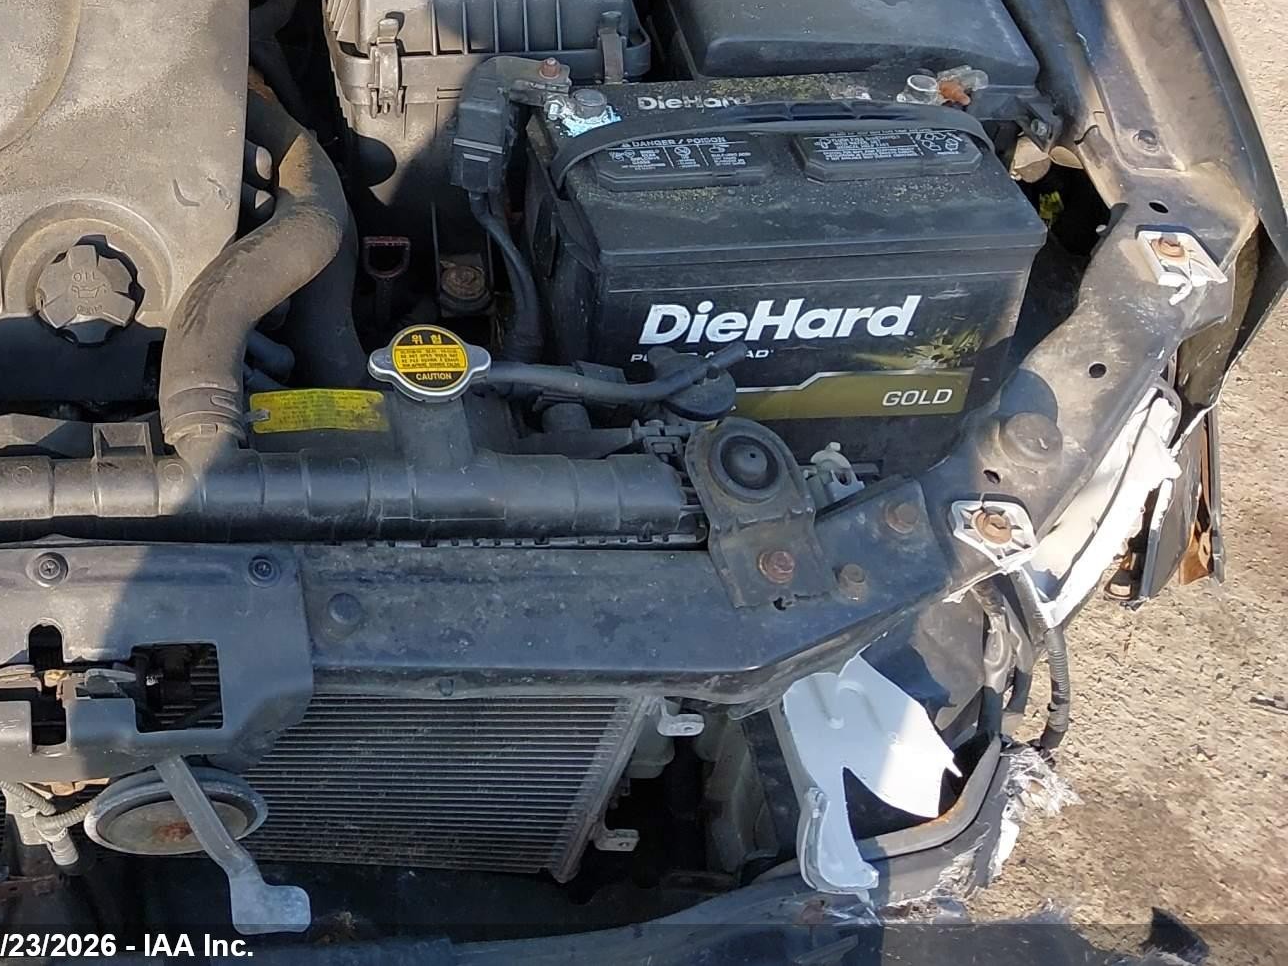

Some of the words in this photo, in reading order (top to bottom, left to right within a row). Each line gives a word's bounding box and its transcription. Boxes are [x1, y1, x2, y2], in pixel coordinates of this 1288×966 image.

[637, 94, 752, 110] DieHard
[632, 139, 673, 147] DANGER
[686, 136, 726, 144] POISON
[73, 271, 100, 282] OIL
[638, 295, 921, 344] DieHard
[416, 372, 452, 380] CAUTION
[882, 388, 953, 407] GOLD
